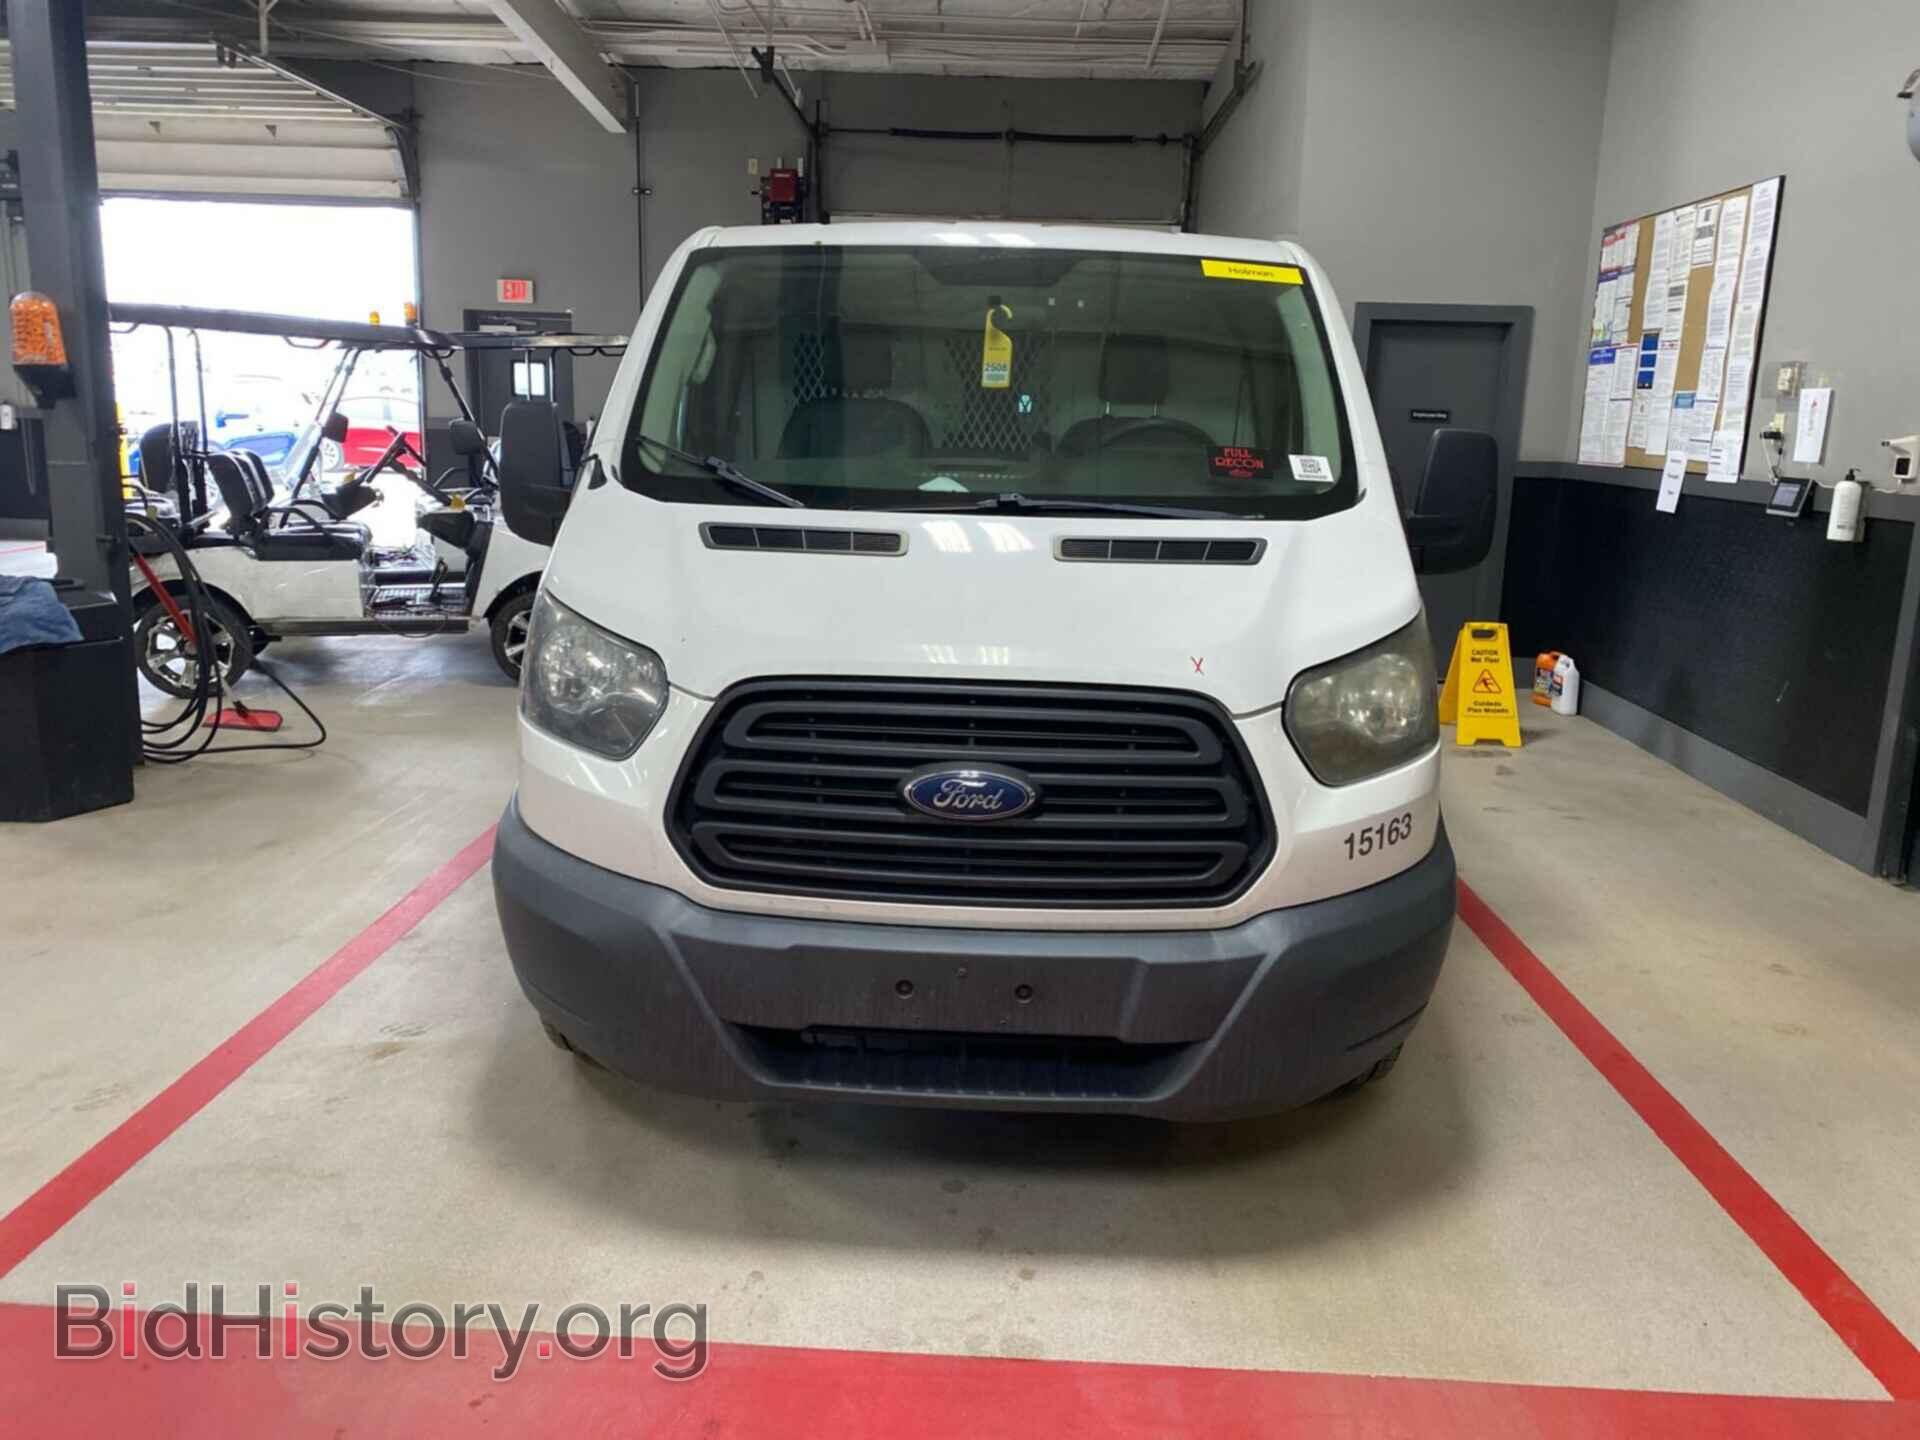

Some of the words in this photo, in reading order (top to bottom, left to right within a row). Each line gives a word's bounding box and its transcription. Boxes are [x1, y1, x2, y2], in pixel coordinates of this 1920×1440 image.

[503, 281, 528, 300] EXIT
[1224, 448, 1251, 459] FULL
[933, 779, 1003, 809] Ford
[1344, 812, 1412, 860] 15163
